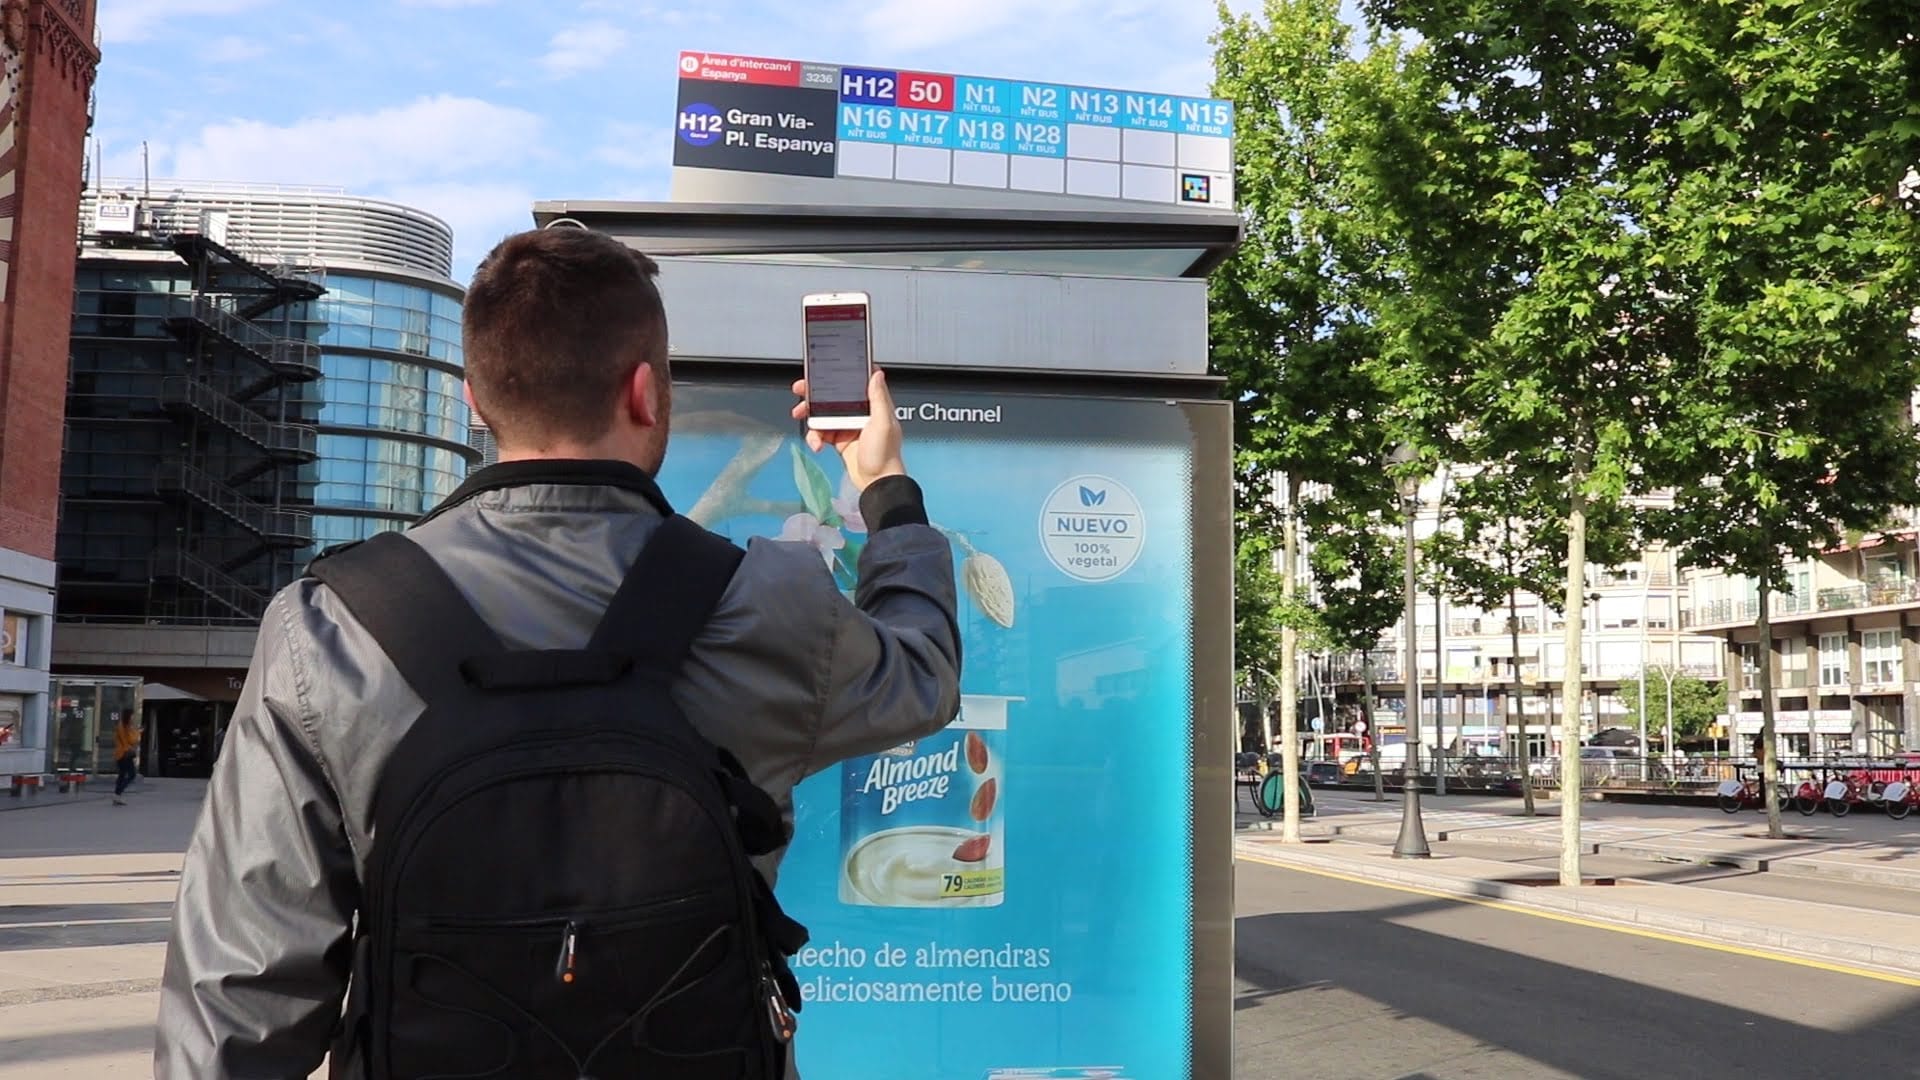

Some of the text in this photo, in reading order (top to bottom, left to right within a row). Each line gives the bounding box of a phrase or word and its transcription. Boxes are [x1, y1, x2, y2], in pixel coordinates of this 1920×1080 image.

[701, 68, 747, 80] Espanya
[806, 73, 832, 84] 3236
[843, 74, 894, 98] H12
[910, 81, 942, 102] 50
[966, 84, 995, 103] N1
[1022, 87, 1057, 108] N2
[1070, 91, 1118, 114] N13
[1127, 96, 1173, 118] N14
[844, 106, 892, 128] N16
[981, 104, 1001, 114] BUS
[1038, 108, 1058, 118] BUS
[1180, 102, 1228, 125] N15
[679, 112, 722, 132] H12
[727, 108, 814, 130] Gran Via-
[900, 111, 950, 134] N17
[1093, 114, 1112, 124] BUS
[1149, 118, 1168, 128] BUS
[866, 130, 886, 140] BUS
[958, 120, 1006, 141] N18
[1015, 122, 1061, 144] N28
[1202, 125, 1222, 134] BUS
[726, 131, 834, 155] Pl. Espanya
[922, 135, 942, 145] BUS
[980, 141, 1000, 150] BUS
[1036, 144, 1057, 154] BUS
[895, 403, 1001, 422] ar Channel
[1057, 518, 1128, 534] NUEVO
[1075, 542, 1111, 554] 100%
[1067, 556, 1118, 568] vegetal
[864, 741, 960, 794] Almond
[881, 774, 950, 815] Breeze
[944, 875, 963, 892] 79
[874, 942, 907, 968] de
[915, 942, 1050, 968] almendras
[796, 976, 1072, 1002] eliciosamente bueno
